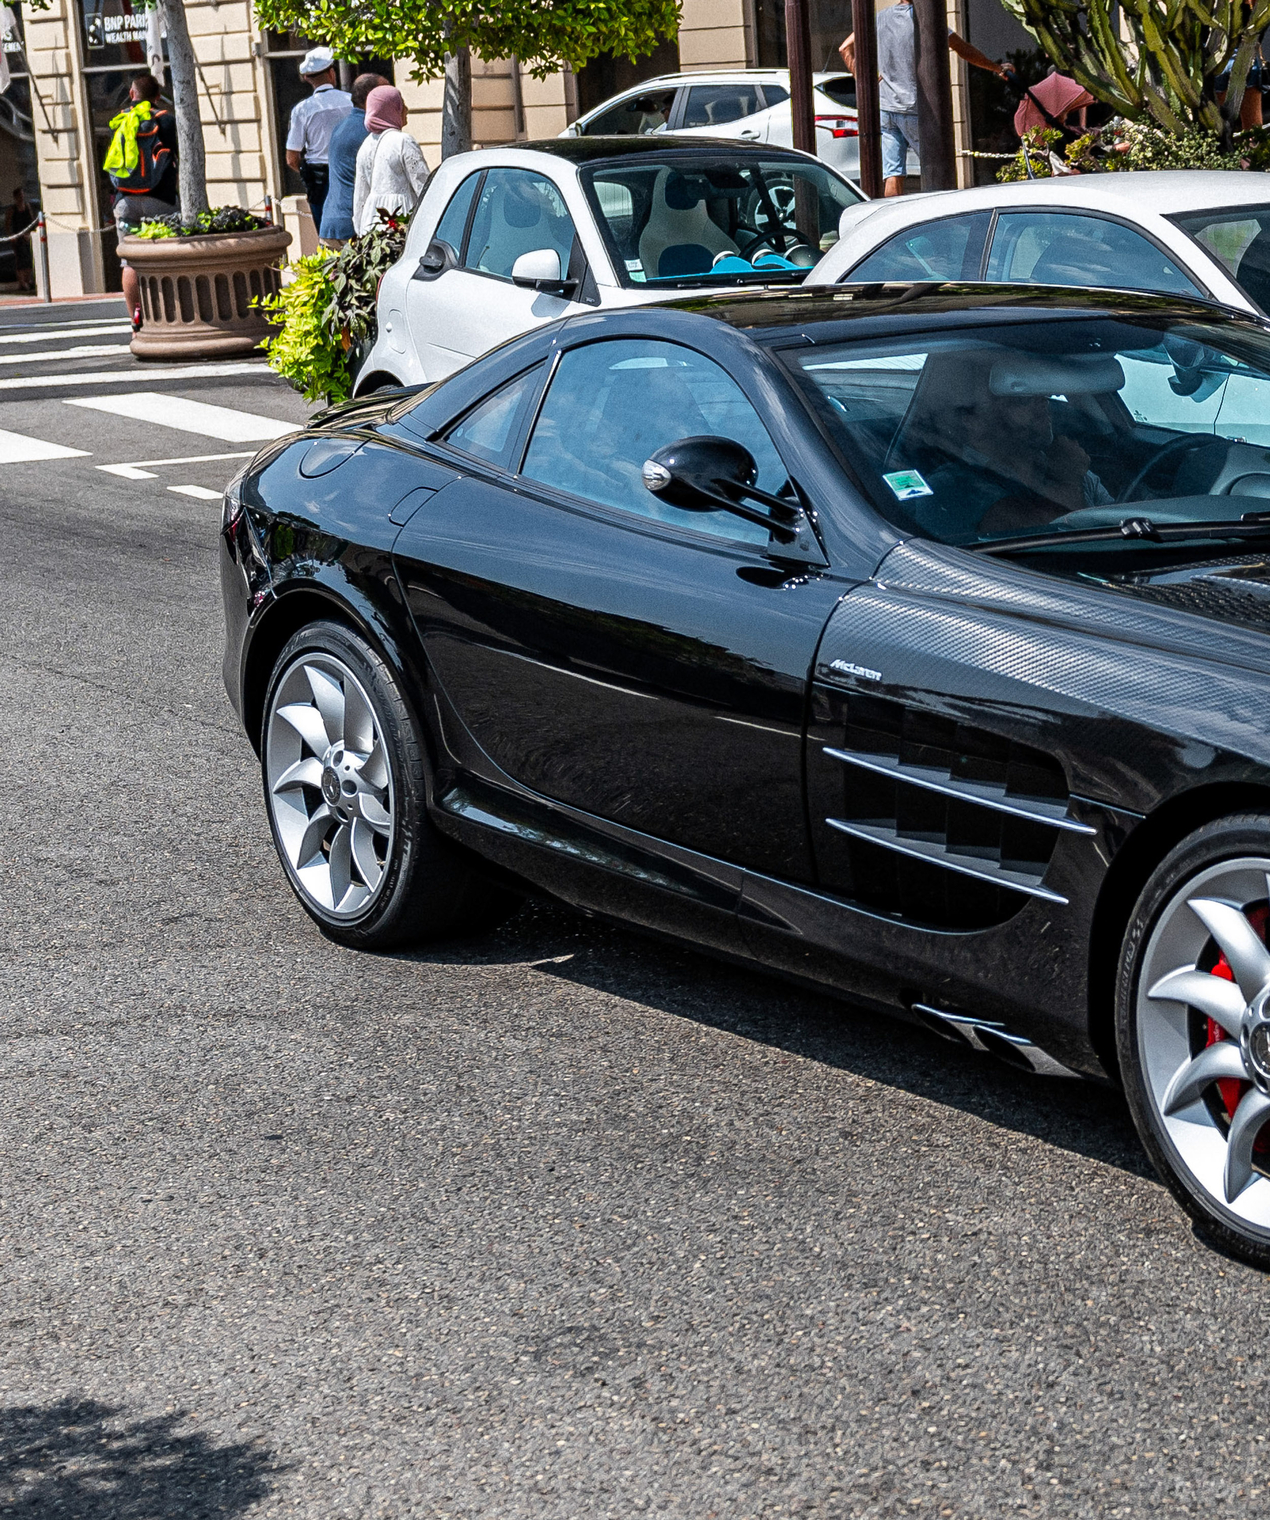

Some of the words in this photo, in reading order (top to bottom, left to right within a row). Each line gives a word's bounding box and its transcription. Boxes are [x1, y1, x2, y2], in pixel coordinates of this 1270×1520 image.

[104, 15, 124, 32] BNP
[105, 31, 132, 44] WEALTH
[829, 658, 882, 681] McLaren
